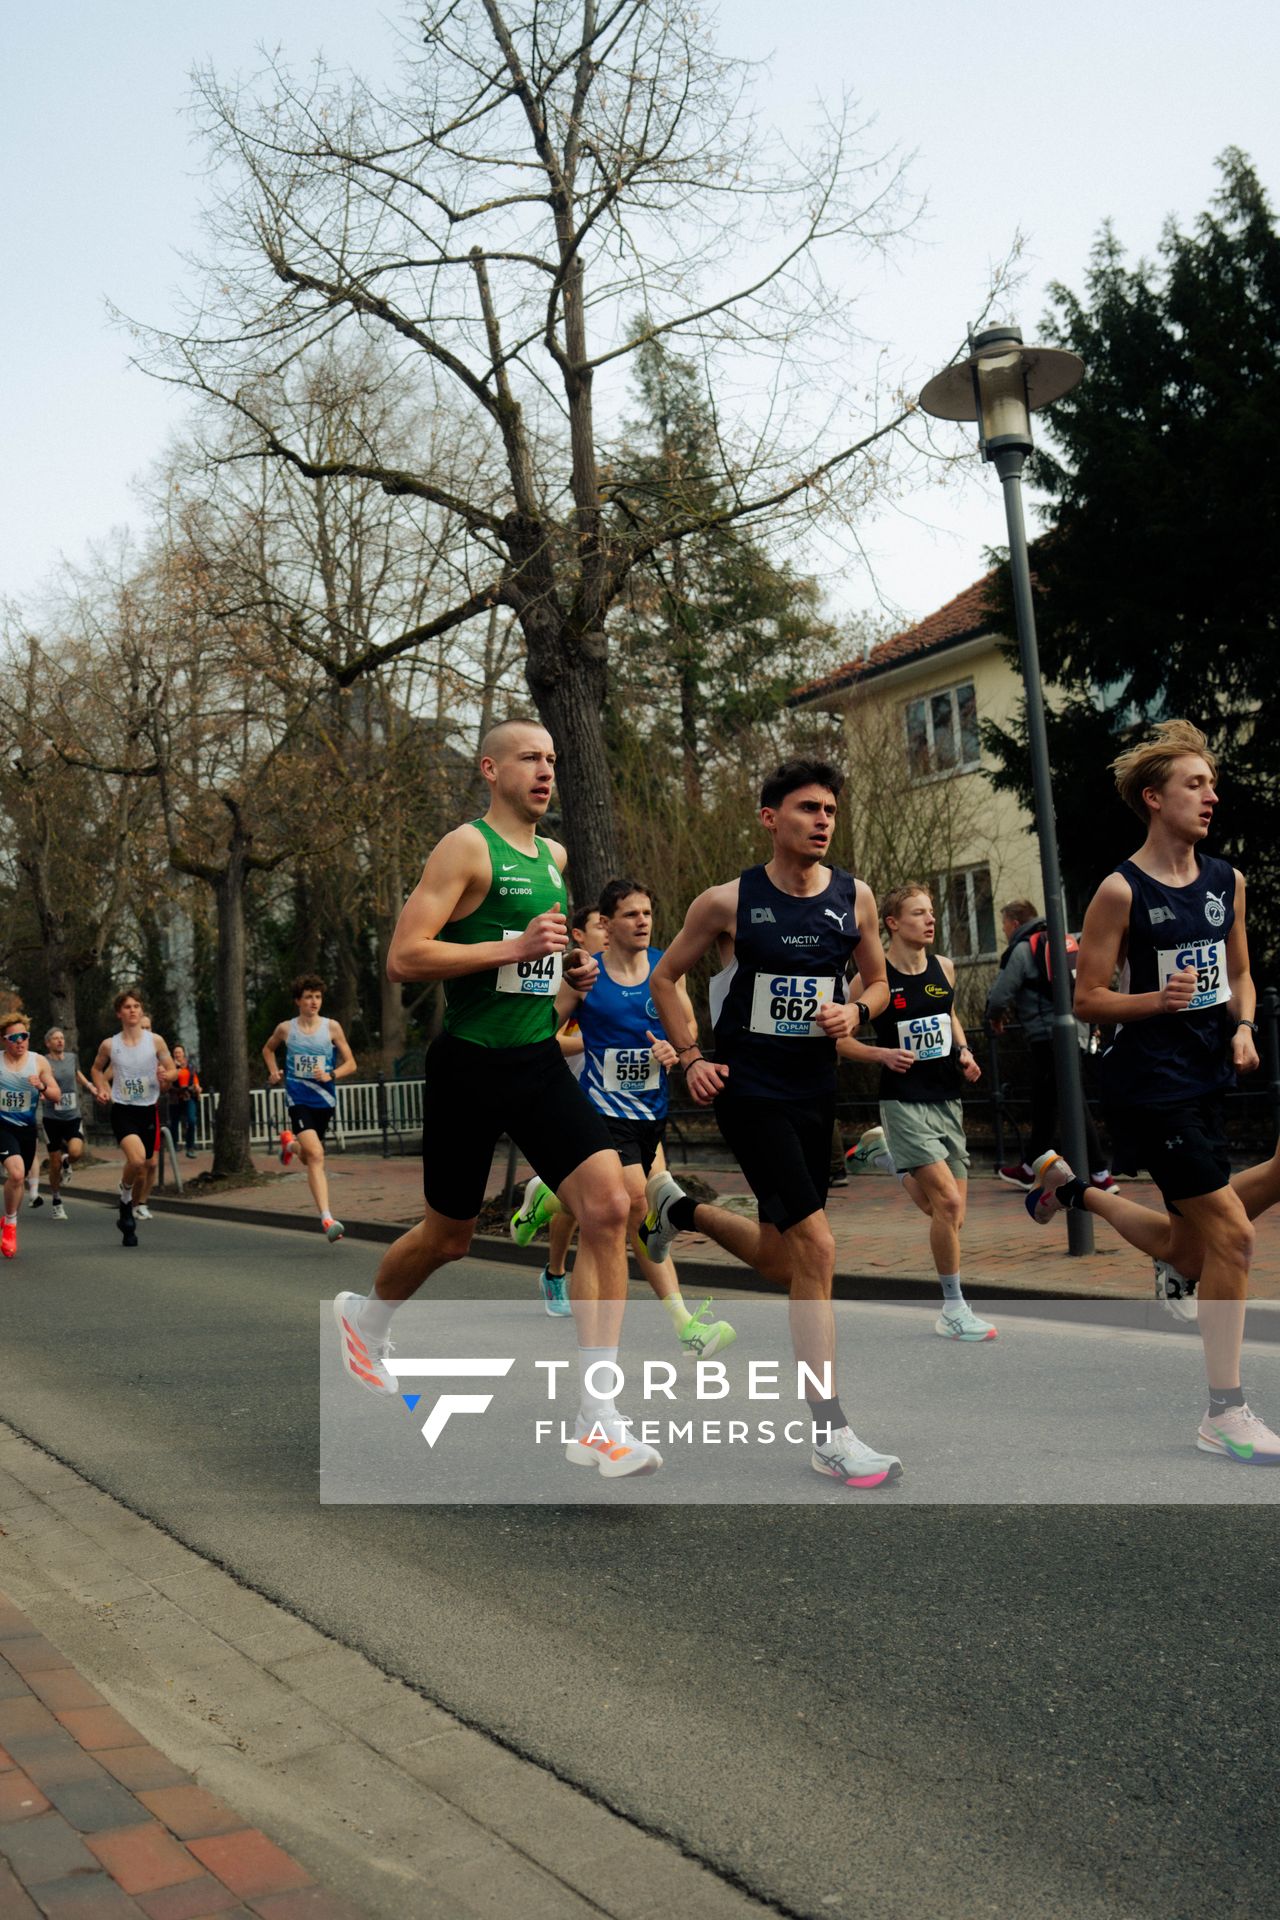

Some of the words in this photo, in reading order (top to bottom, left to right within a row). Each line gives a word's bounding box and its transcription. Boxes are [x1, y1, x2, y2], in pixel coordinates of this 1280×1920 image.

[509, 887, 533, 895] CUBOS
[781, 936, 820, 944] VIACTIV
[1176, 939, 1213, 950] VIACTIV
[1176, 946, 1217, 970] GLS
[517, 956, 555, 979] 644
[534, 981, 549, 989] PLAN
[1202, 993, 1217, 1002] PLAN
[769, 997, 818, 1021] 662
[909, 1016, 940, 1034] GLS
[912, 1029, 944, 1050] 704
[300, 1055, 318, 1064] GLS
[615, 1050, 650, 1064] GLS
[616, 1064, 650, 1081] 555
[125, 1078, 143, 1087] GLS
[6, 1091, 25, 1099] GLS
[127, 1085, 145, 1095] 758
[6, 1098, 25, 1108] 812
